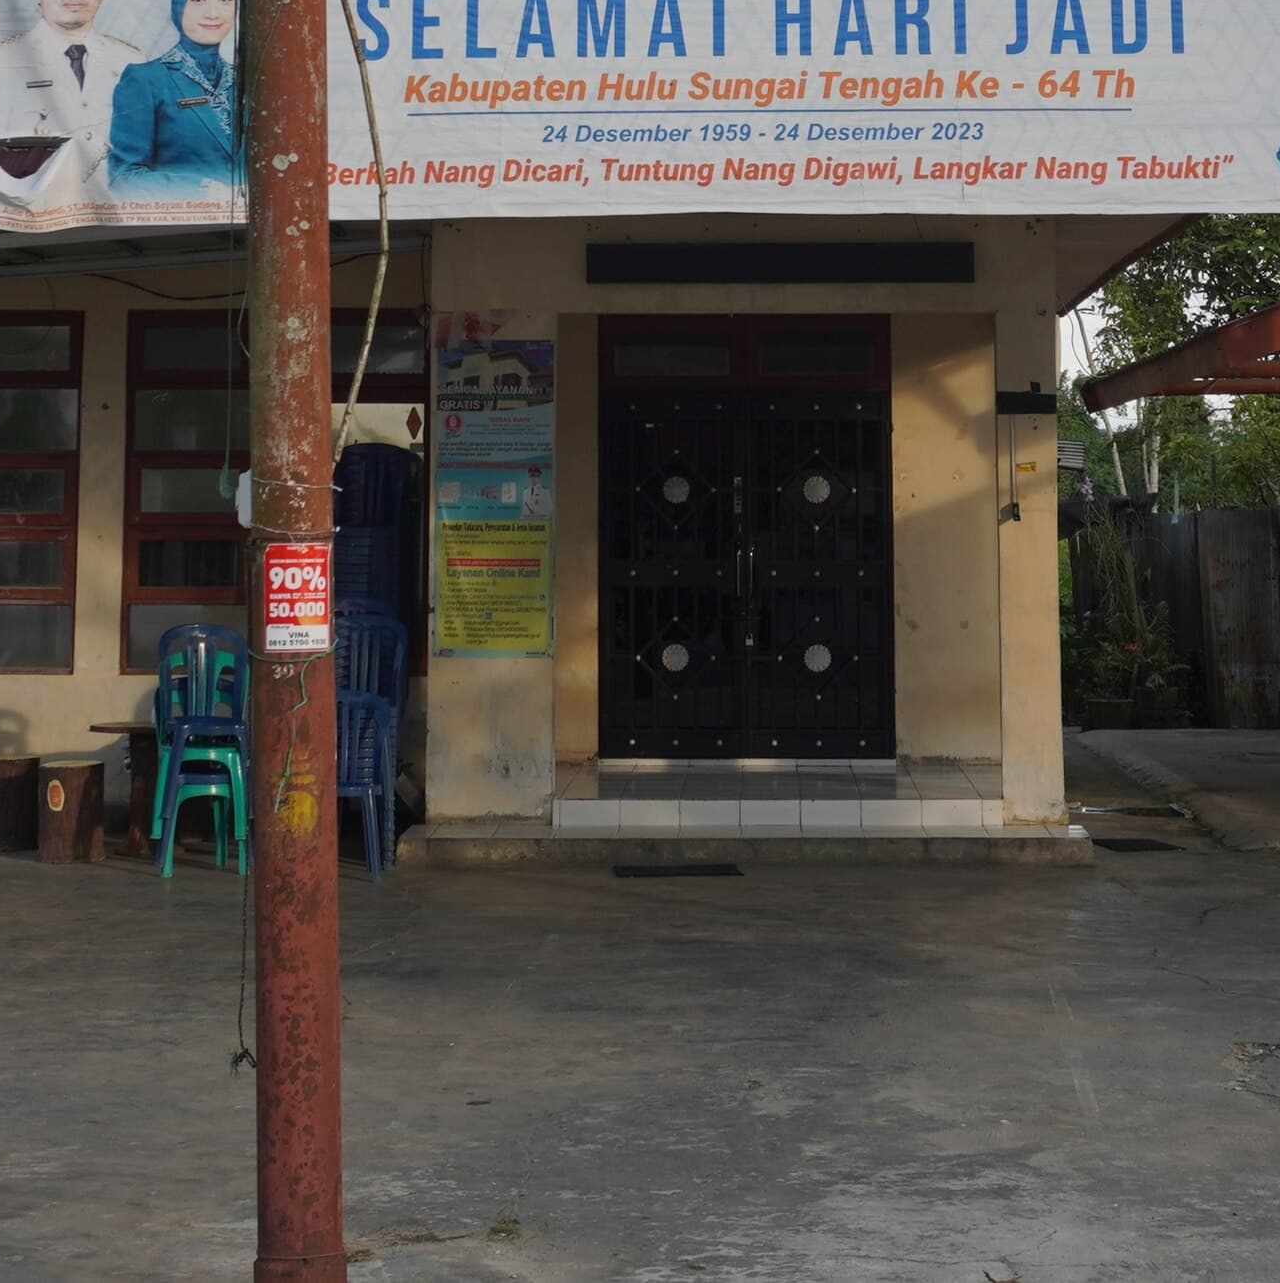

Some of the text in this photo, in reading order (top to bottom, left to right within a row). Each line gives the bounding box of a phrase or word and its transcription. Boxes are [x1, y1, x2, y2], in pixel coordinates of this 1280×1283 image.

[404, 73, 587, 109] Kabupaten
[597, 72, 678, 101] Hulu
[688, 71, 807, 107] Sungai
[820, 69, 945, 107] Tengah
[956, 70, 1000, 99] Ke
[1038, 70, 1080, 99] 64
[1094, 69, 1135, 98] Th
[543, 125, 567, 143] 24
[575, 124, 690, 143] Desember
[701, 123, 752, 142] 1959
[774, 123, 800, 142] 24
[806, 122, 921, 142] Desember
[932, 122, 984, 140] 2023
[423, 161, 496, 189] Nang
[502, 158, 589, 188] Dicari,
[601, 157, 715, 187] Tuntung
[722, 157, 795, 186] Nang
[803, 157, 901, 186] Digawi,
[913, 157, 1026, 186] Langkar
[1035, 157, 1108, 185] Nang
[439, 400, 480, 411] GRATIS
[269, 566, 327, 591] 90%
[268, 602, 325, 618] 50.000
[288, 631, 310, 639] VINA
